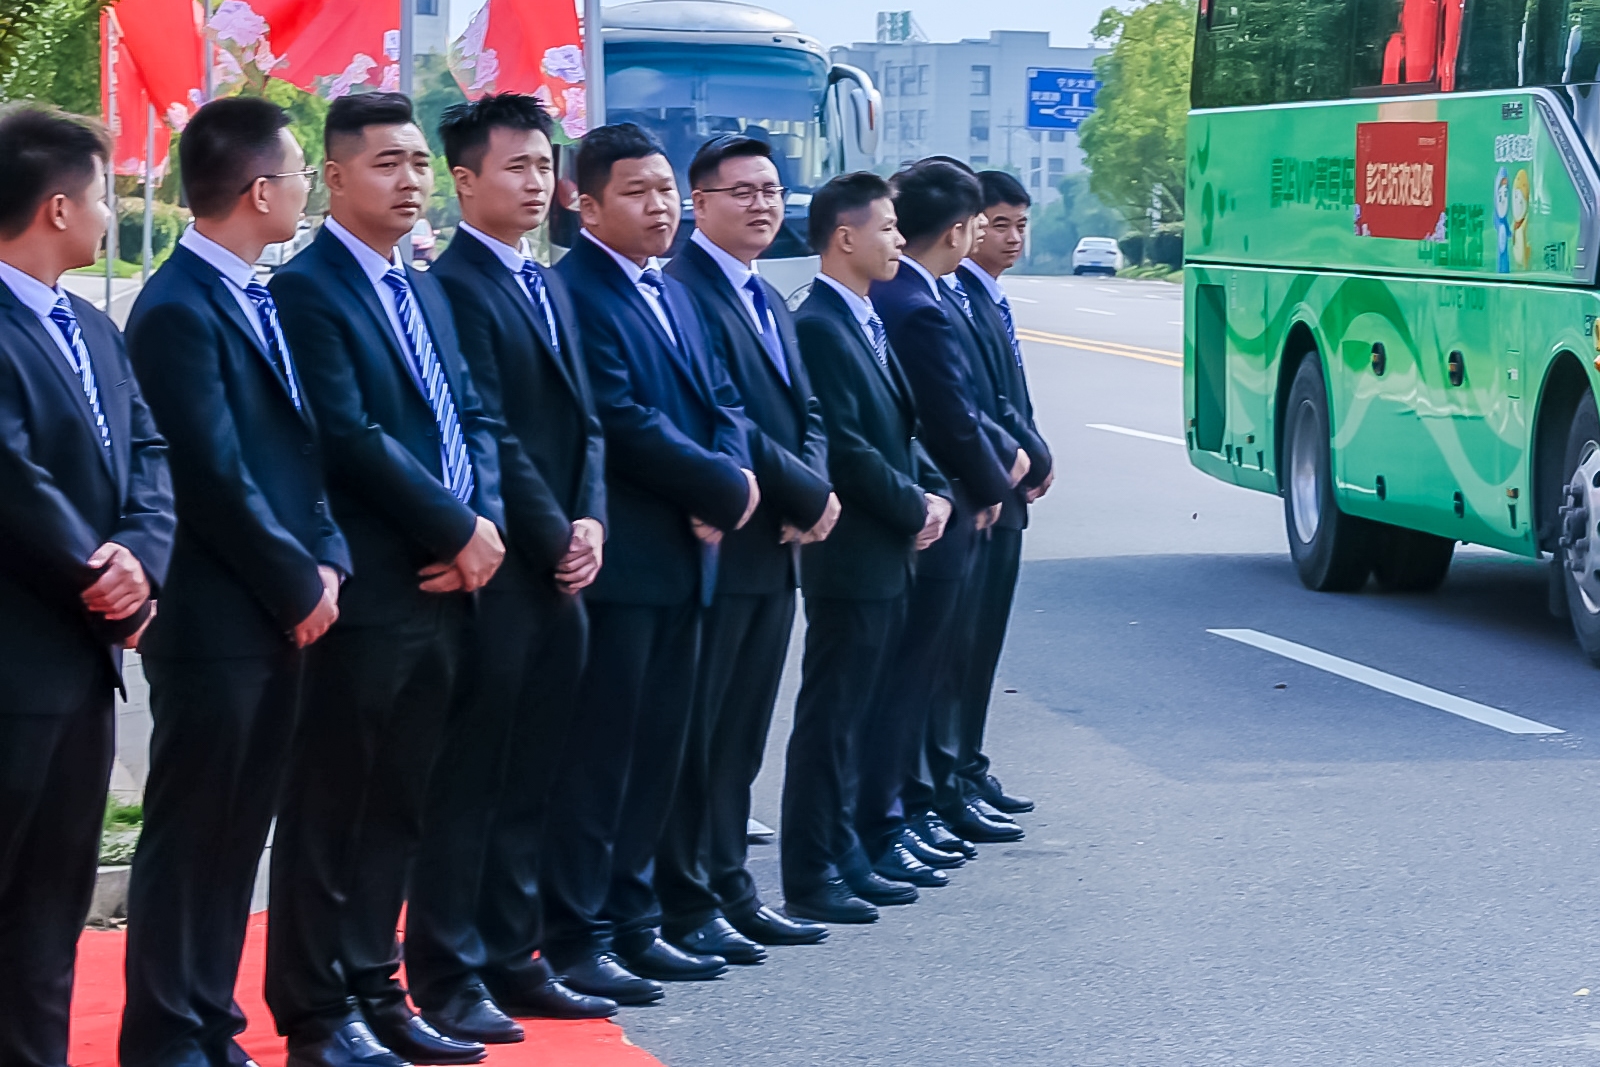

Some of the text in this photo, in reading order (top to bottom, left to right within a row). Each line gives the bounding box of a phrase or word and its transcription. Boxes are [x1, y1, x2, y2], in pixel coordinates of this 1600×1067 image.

[1365, 162, 1434, 207] 彭记坊欢迎您
